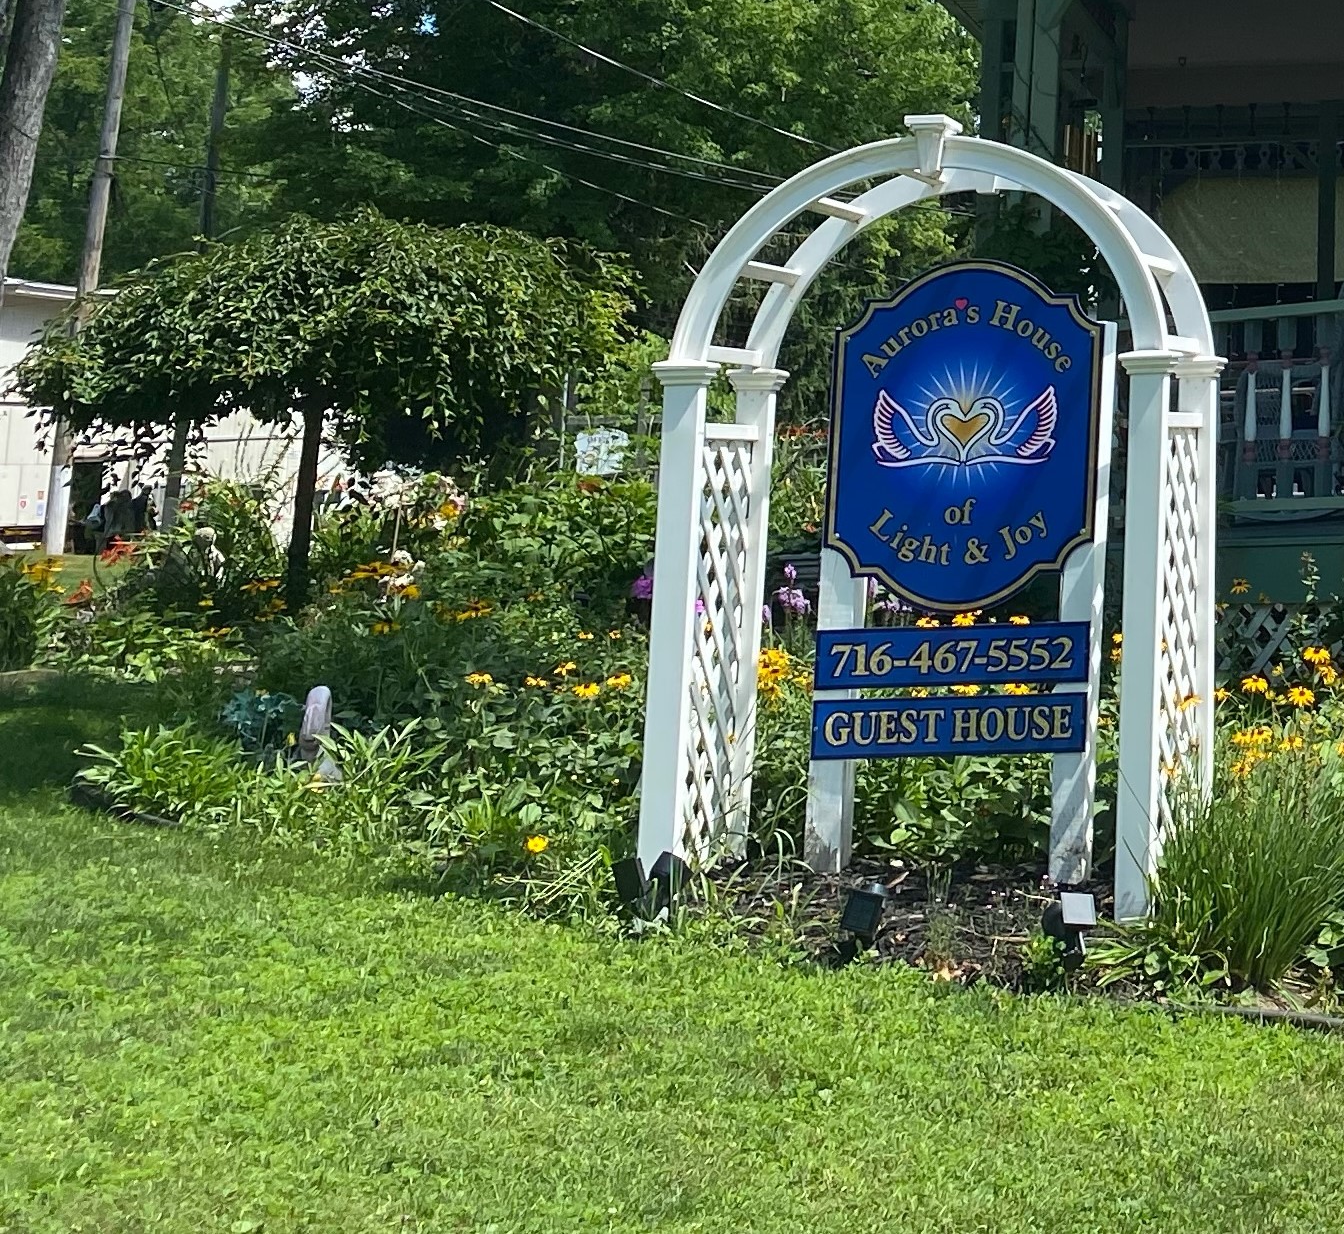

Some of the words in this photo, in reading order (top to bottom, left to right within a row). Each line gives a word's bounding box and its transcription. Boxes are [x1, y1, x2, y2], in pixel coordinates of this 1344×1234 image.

[861, 297, 980, 379] Aurora's
[989, 299, 1072, 373] House
[944, 498, 977, 526] of
[869, 508, 950, 566] Light
[964, 537, 990, 565] &
[998, 511, 1048, 561] Joy
[829, 637, 1074, 678] 716-467-5552
[824, 710, 944, 747] GUEST
[952, 705, 1073, 742] HOUSE
